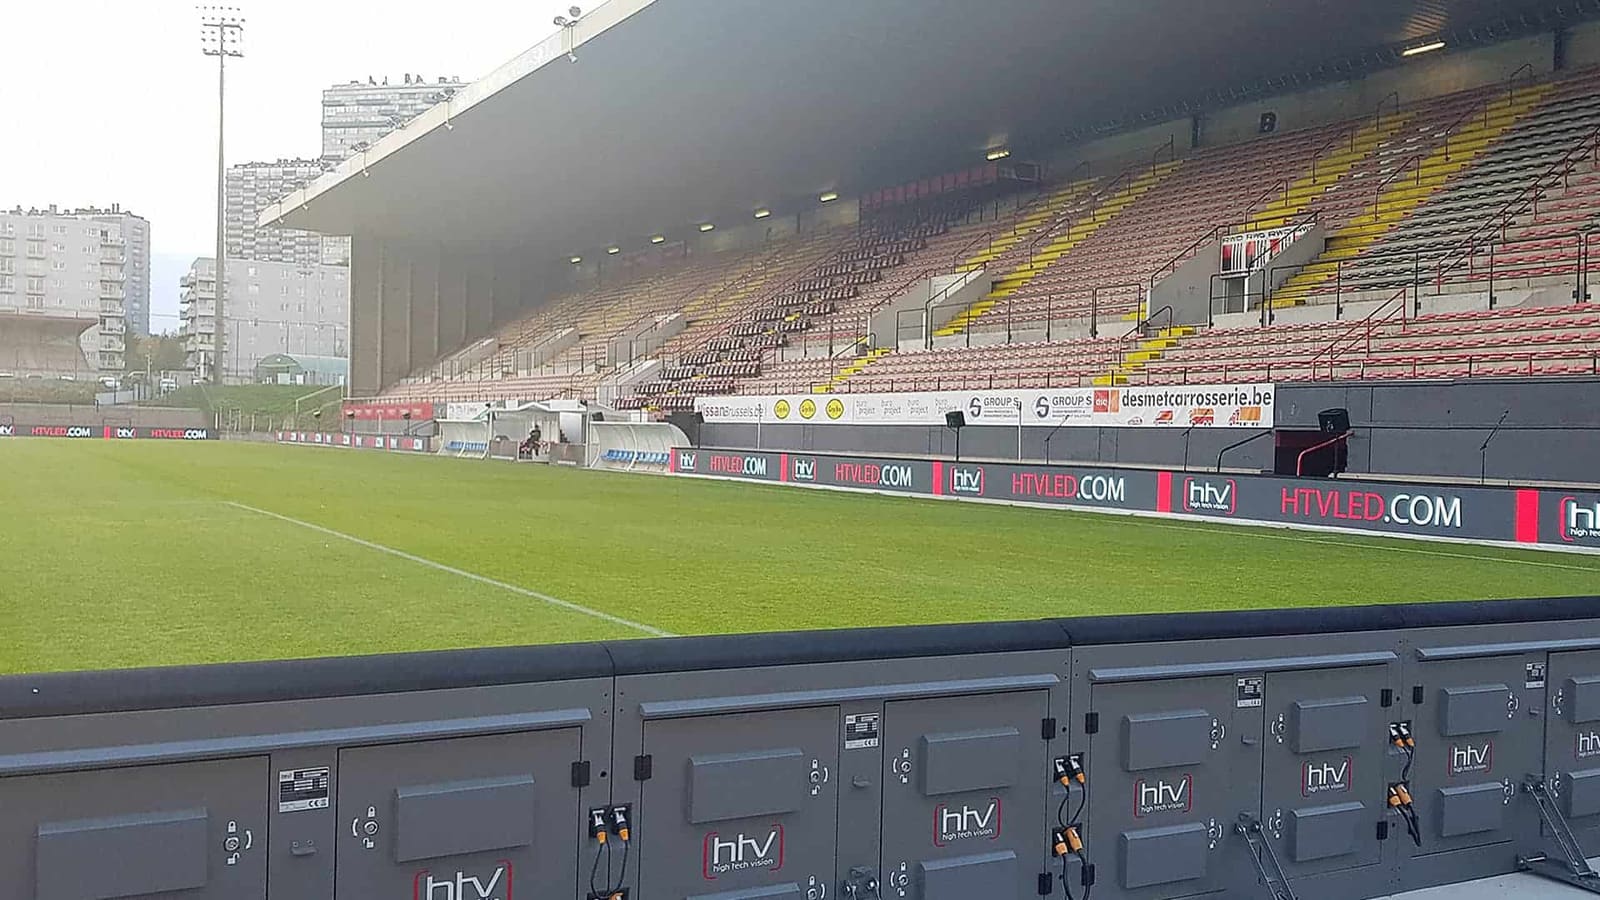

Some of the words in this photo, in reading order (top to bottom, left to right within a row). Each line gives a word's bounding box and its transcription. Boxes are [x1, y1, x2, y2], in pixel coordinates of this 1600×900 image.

[984, 397, 1012, 407] GROUP
[1052, 396, 1084, 406] GROUP
[1086, 396, 1092, 406] S
[1122, 386, 1272, 408] desmetcarrosserie.be
[31, 426, 91, 437] HTVLED.COM
[151, 429, 207, 439] HTVLED.COM
[710, 455, 766, 475] HTVLED.COM
[795, 459, 814, 475] htv
[835, 463, 912, 487] HTVLED.COM
[954, 469, 981, 487] htv
[1012, 473, 1125, 502] HTVLED.COM
[1190, 481, 1231, 504] htv
[1281, 488, 1462, 528] HTVLED.COM
[1454, 744, 1489, 767] htv
[1308, 761, 1347, 786] htv
[1141, 779, 1187, 806] htv
[943, 803, 995, 833] htv
[713, 831, 777, 864] htv
[713, 863, 730, 873] high
[731, 860, 749, 871] tech
[750, 857, 774, 868] vision
[426, 866, 504, 900] htv
